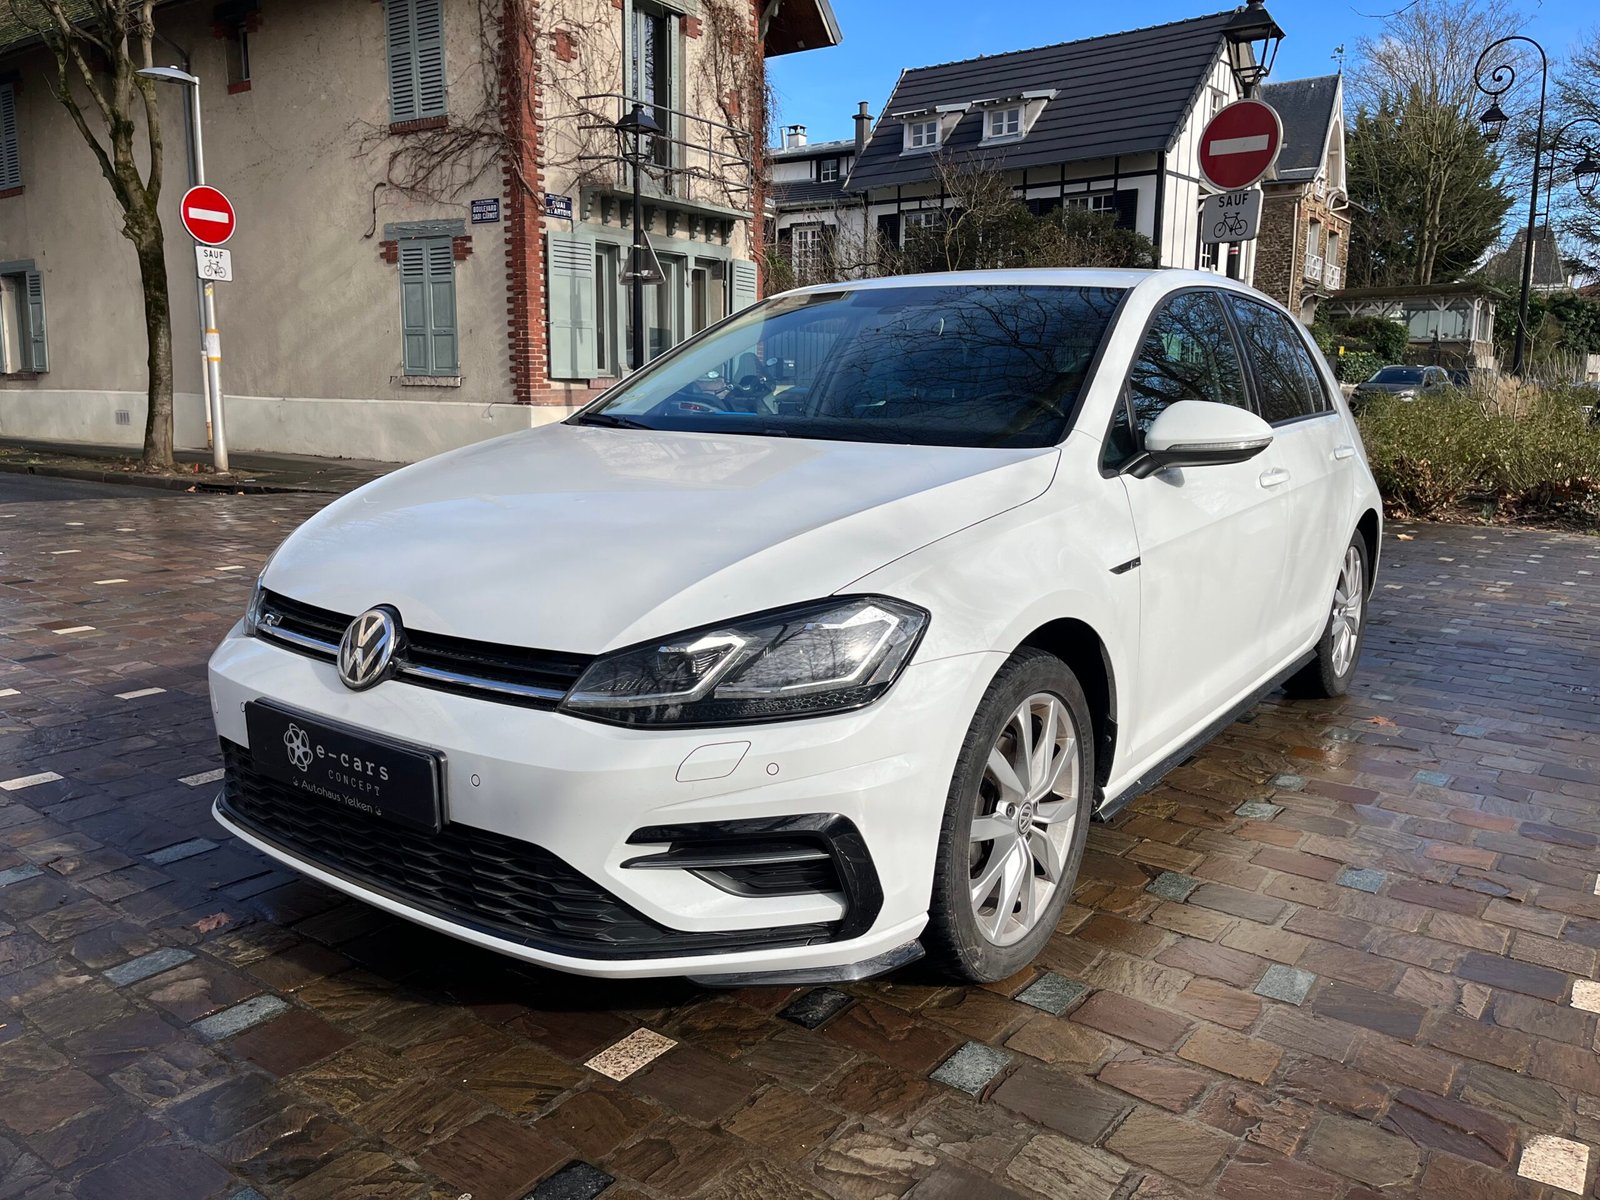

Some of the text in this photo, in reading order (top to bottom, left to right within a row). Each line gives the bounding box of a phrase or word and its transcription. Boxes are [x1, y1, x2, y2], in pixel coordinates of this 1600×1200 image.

[551, 200, 566, 209] QUAI
[1218, 193, 1249, 208] SAUF
[473, 204, 497, 213] BOULEVARD
[203, 249, 223, 259] SAUF
[316, 745, 389, 781] e-cars
[328, 769, 380, 796] CONCEPT
[301, 780, 373, 813] Autohaus Yelken
